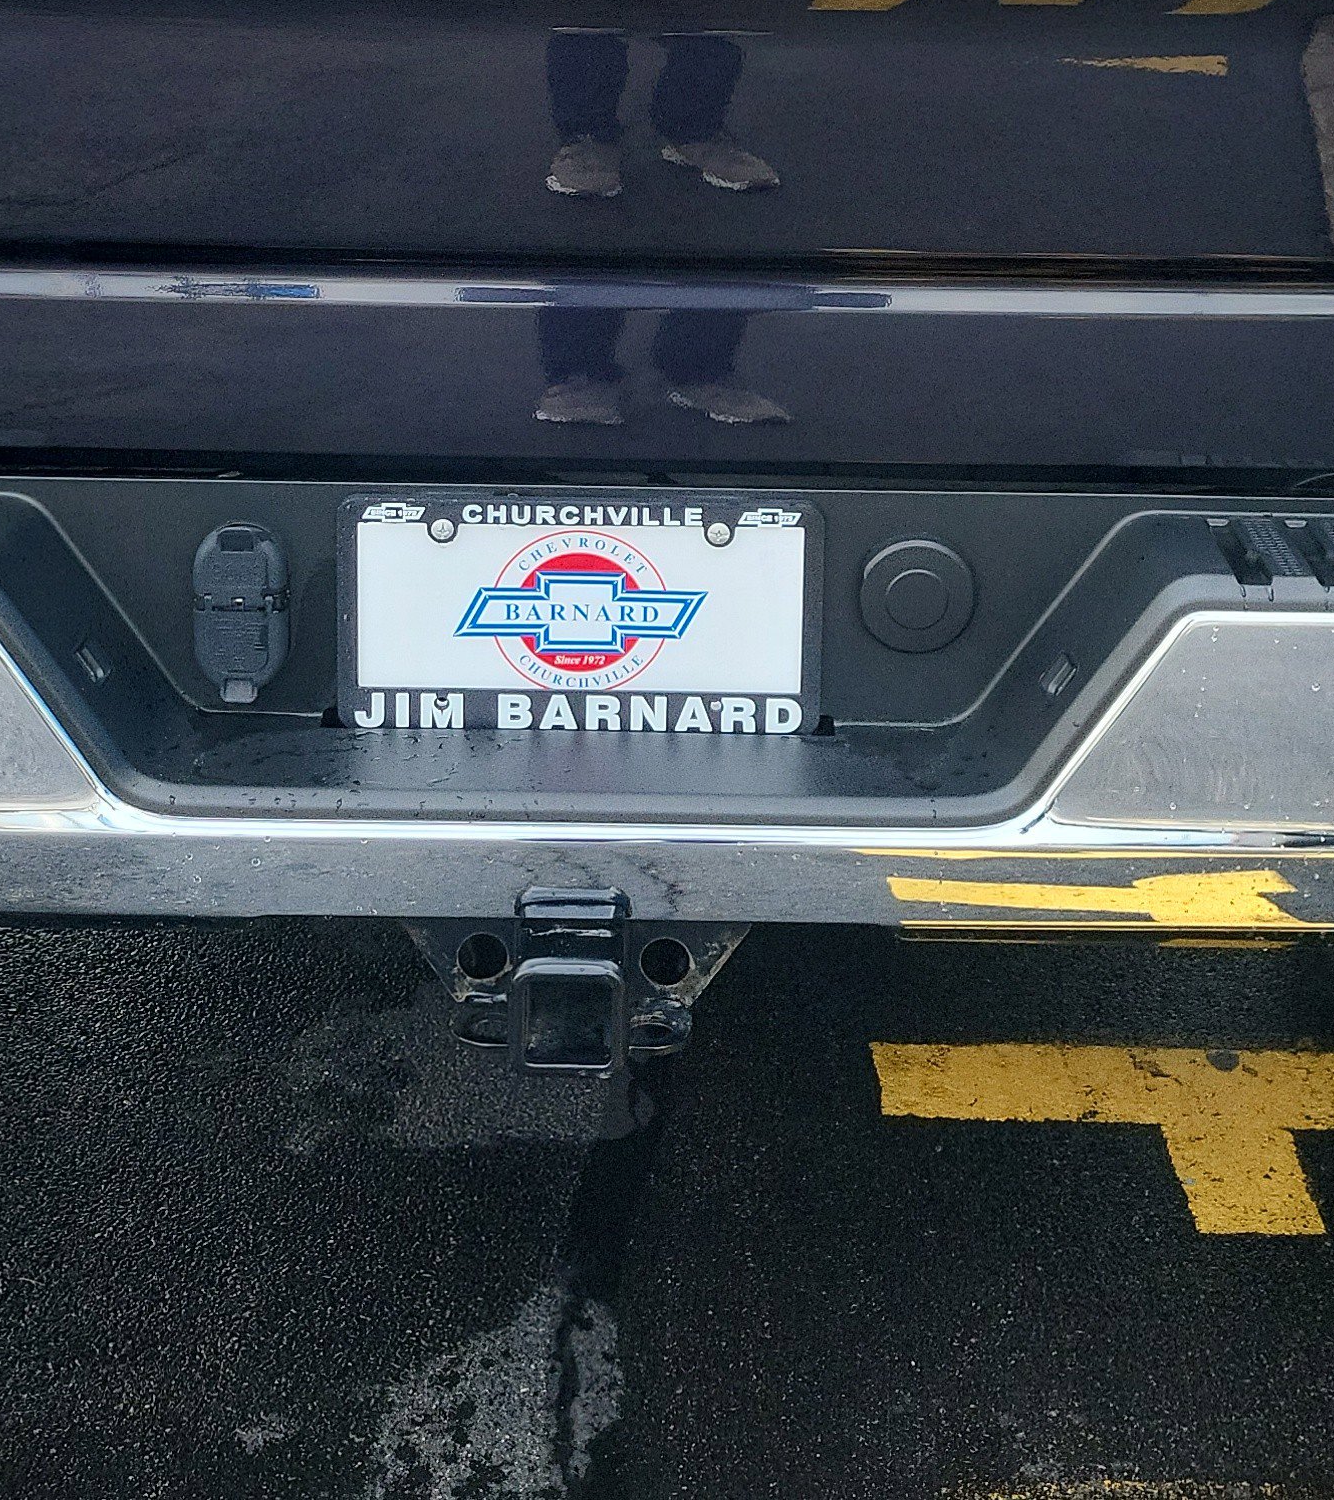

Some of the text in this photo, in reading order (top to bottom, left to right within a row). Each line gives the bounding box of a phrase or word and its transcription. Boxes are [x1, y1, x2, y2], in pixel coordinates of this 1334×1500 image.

[461, 503, 704, 528] CHURCHVILLE
[518, 537, 648, 575] CHEVROLET
[505, 603, 660, 623] BARNARD
[519, 654, 644, 688] CHURCHVILLE
[554, 655, 606, 665] Since 1972
[354, 692, 804, 735] JIM BARNARD
